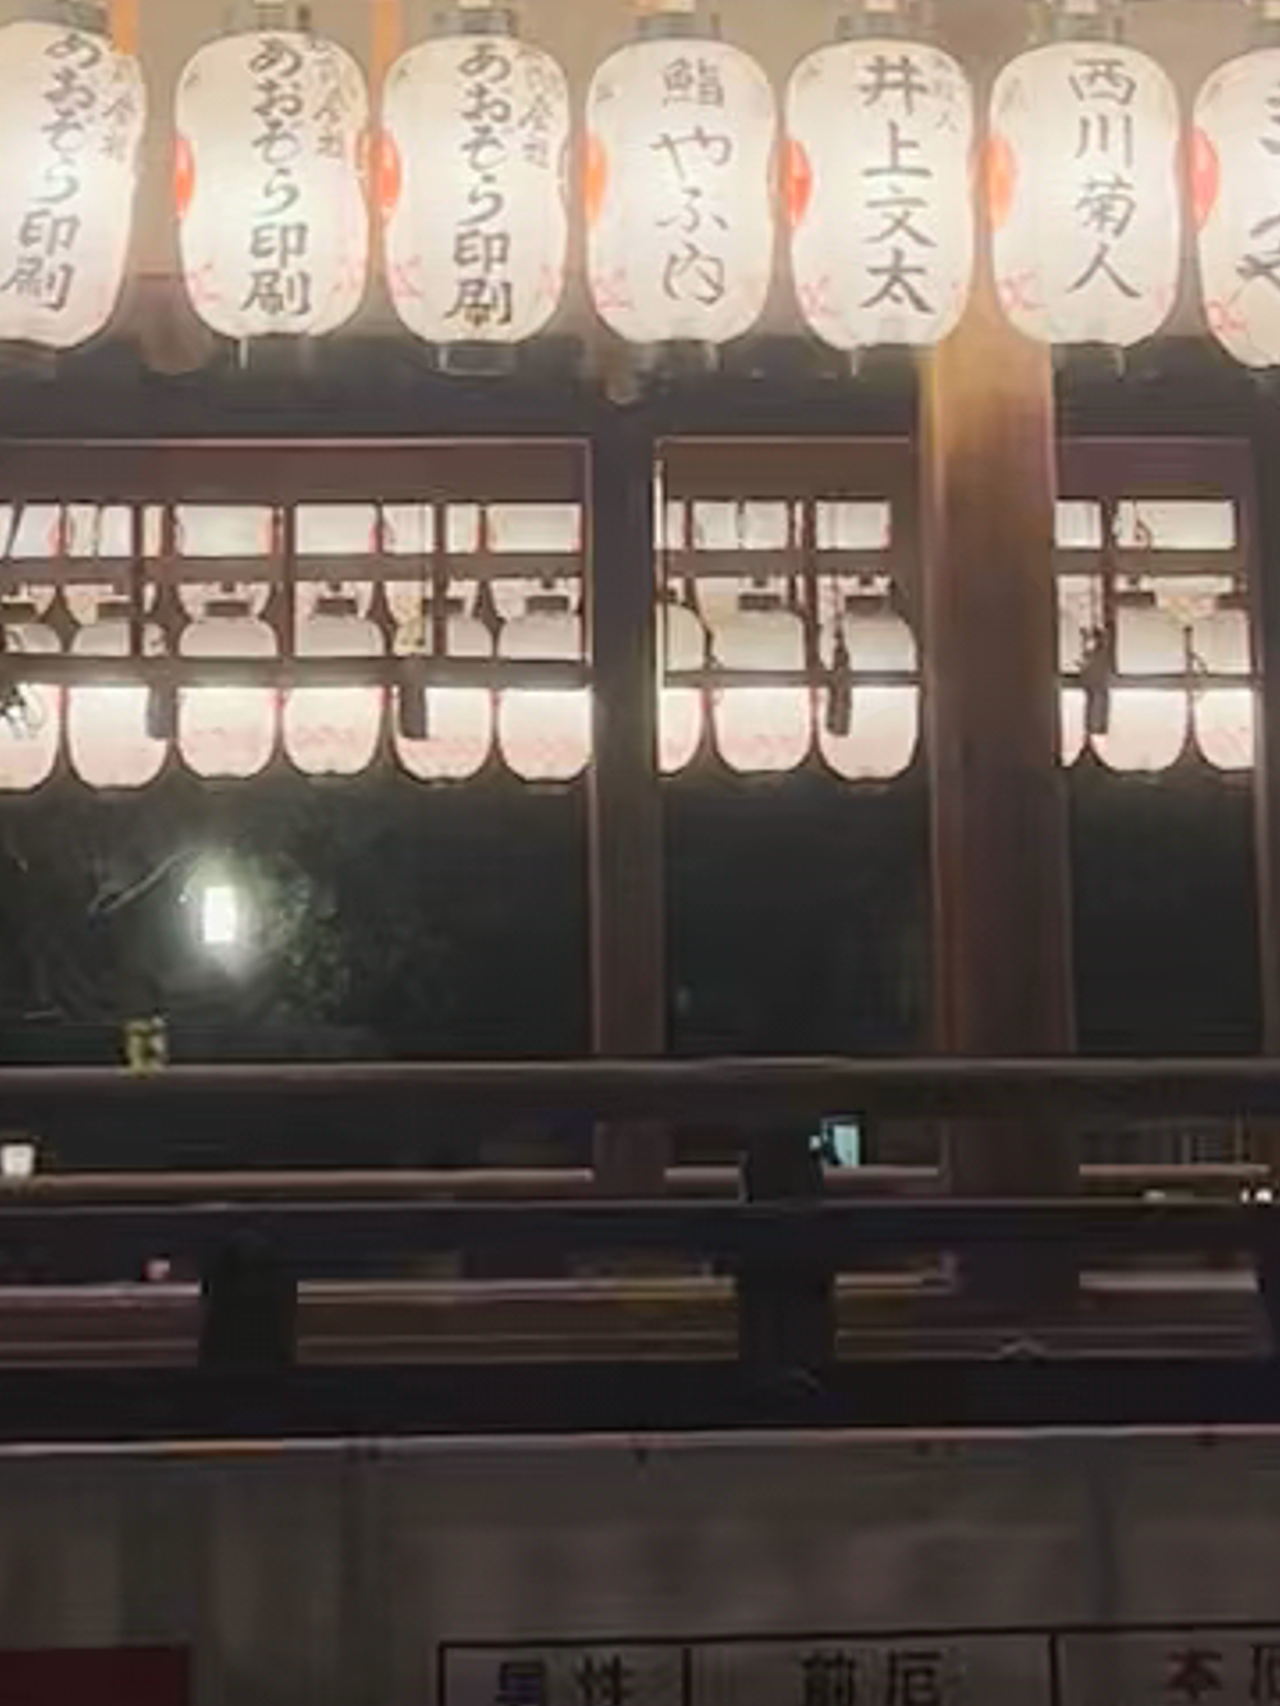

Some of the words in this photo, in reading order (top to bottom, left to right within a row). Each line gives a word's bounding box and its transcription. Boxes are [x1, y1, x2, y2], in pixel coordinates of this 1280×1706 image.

[240, 38, 313, 318] あおぞら印刷
[440, 42, 515, 325] あおぞら印刷
[858, 54, 938, 316] 井上文太
[1066, 57, 1142, 300] 西川菊人
